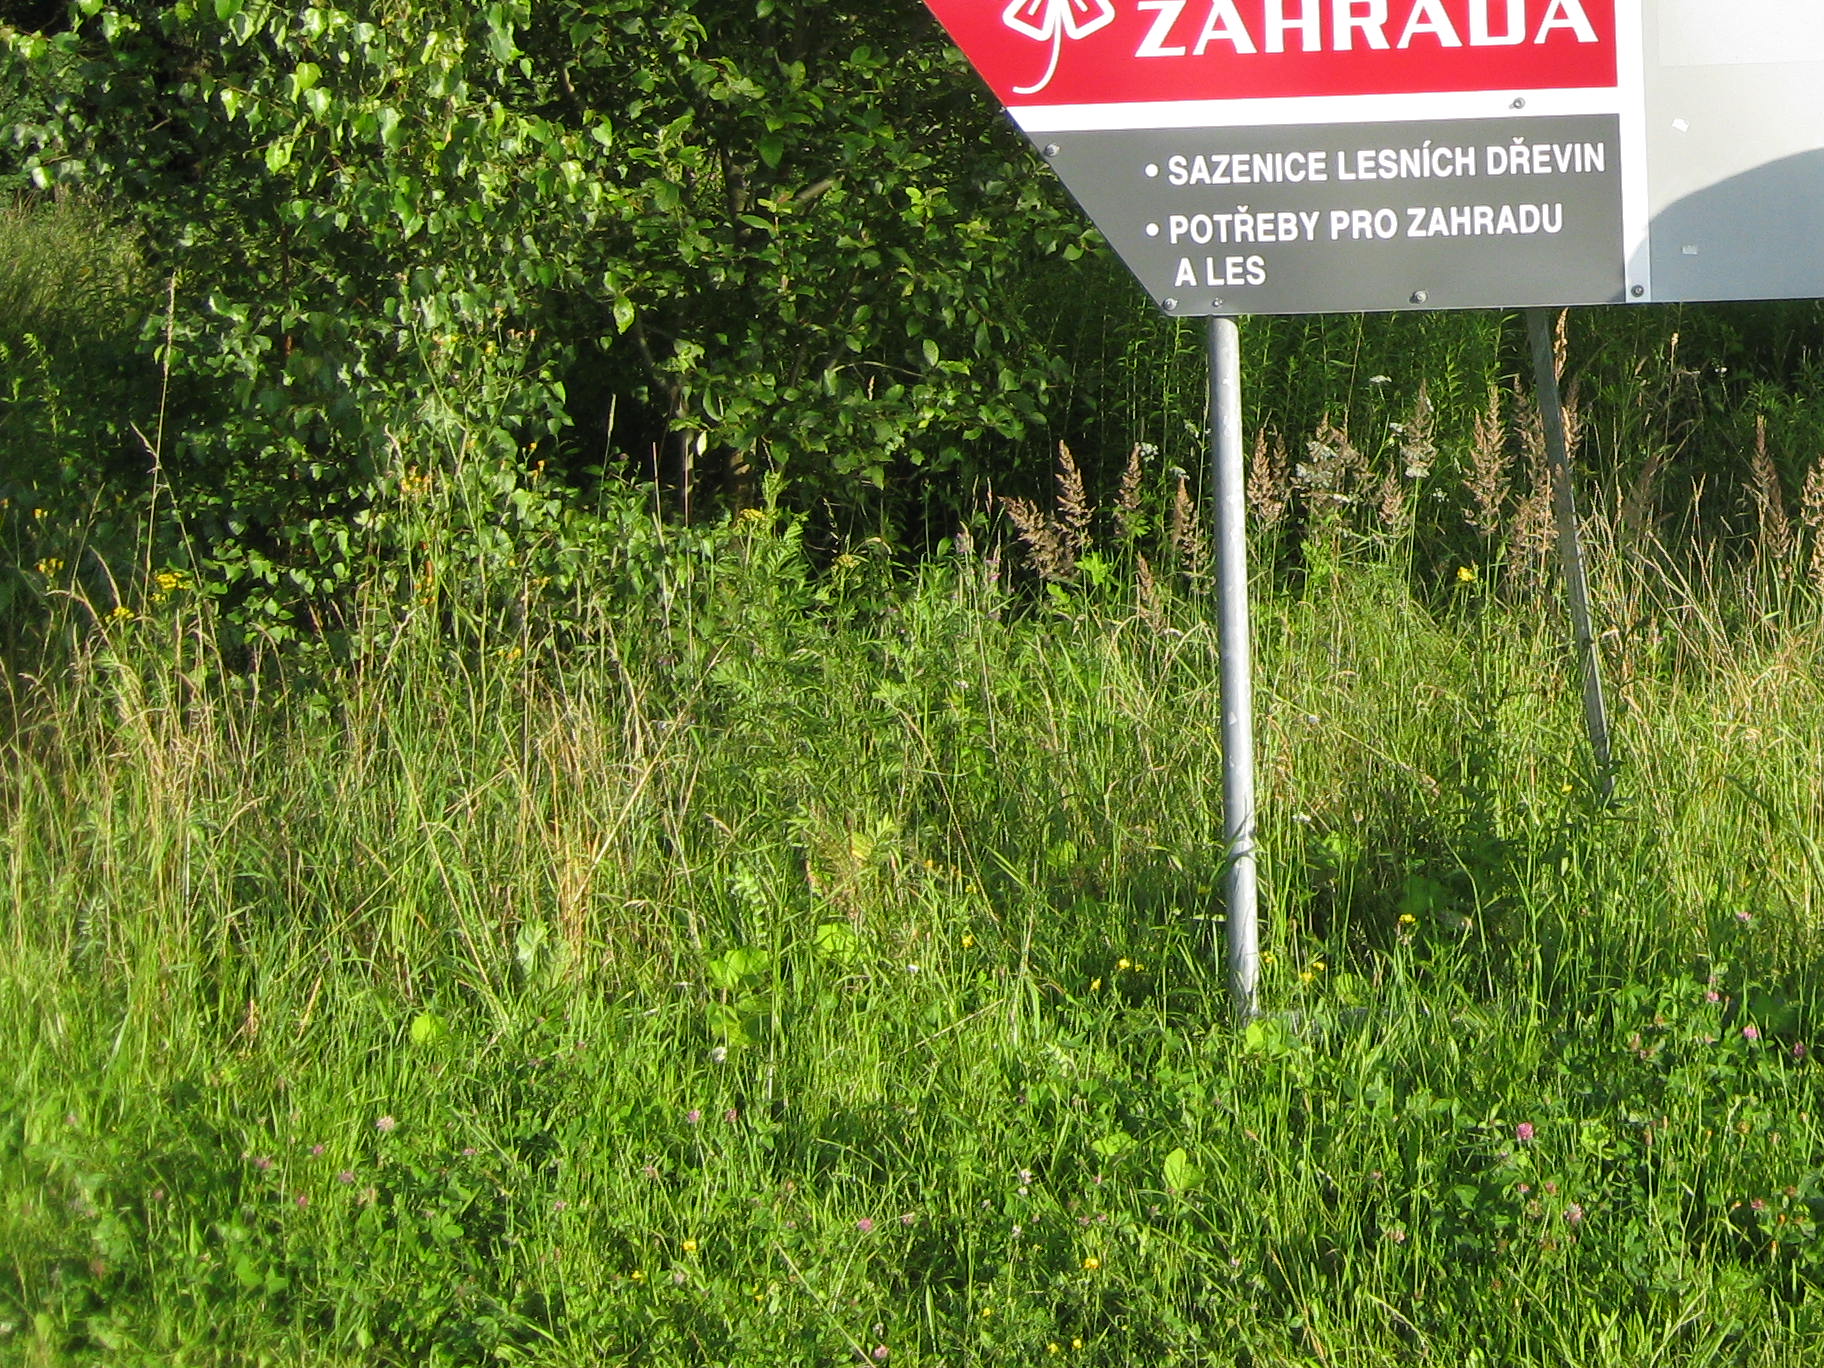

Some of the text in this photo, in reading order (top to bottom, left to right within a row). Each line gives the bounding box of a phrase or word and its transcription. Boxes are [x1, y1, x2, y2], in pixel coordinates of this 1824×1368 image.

[1167, 136, 1606, 186] SAZENICE LESNÍCH DŘEVIN
[1169, 202, 1564, 245] POTŘEBY PRO ZAHRADU
[1174, 255, 1267, 287] A LES
